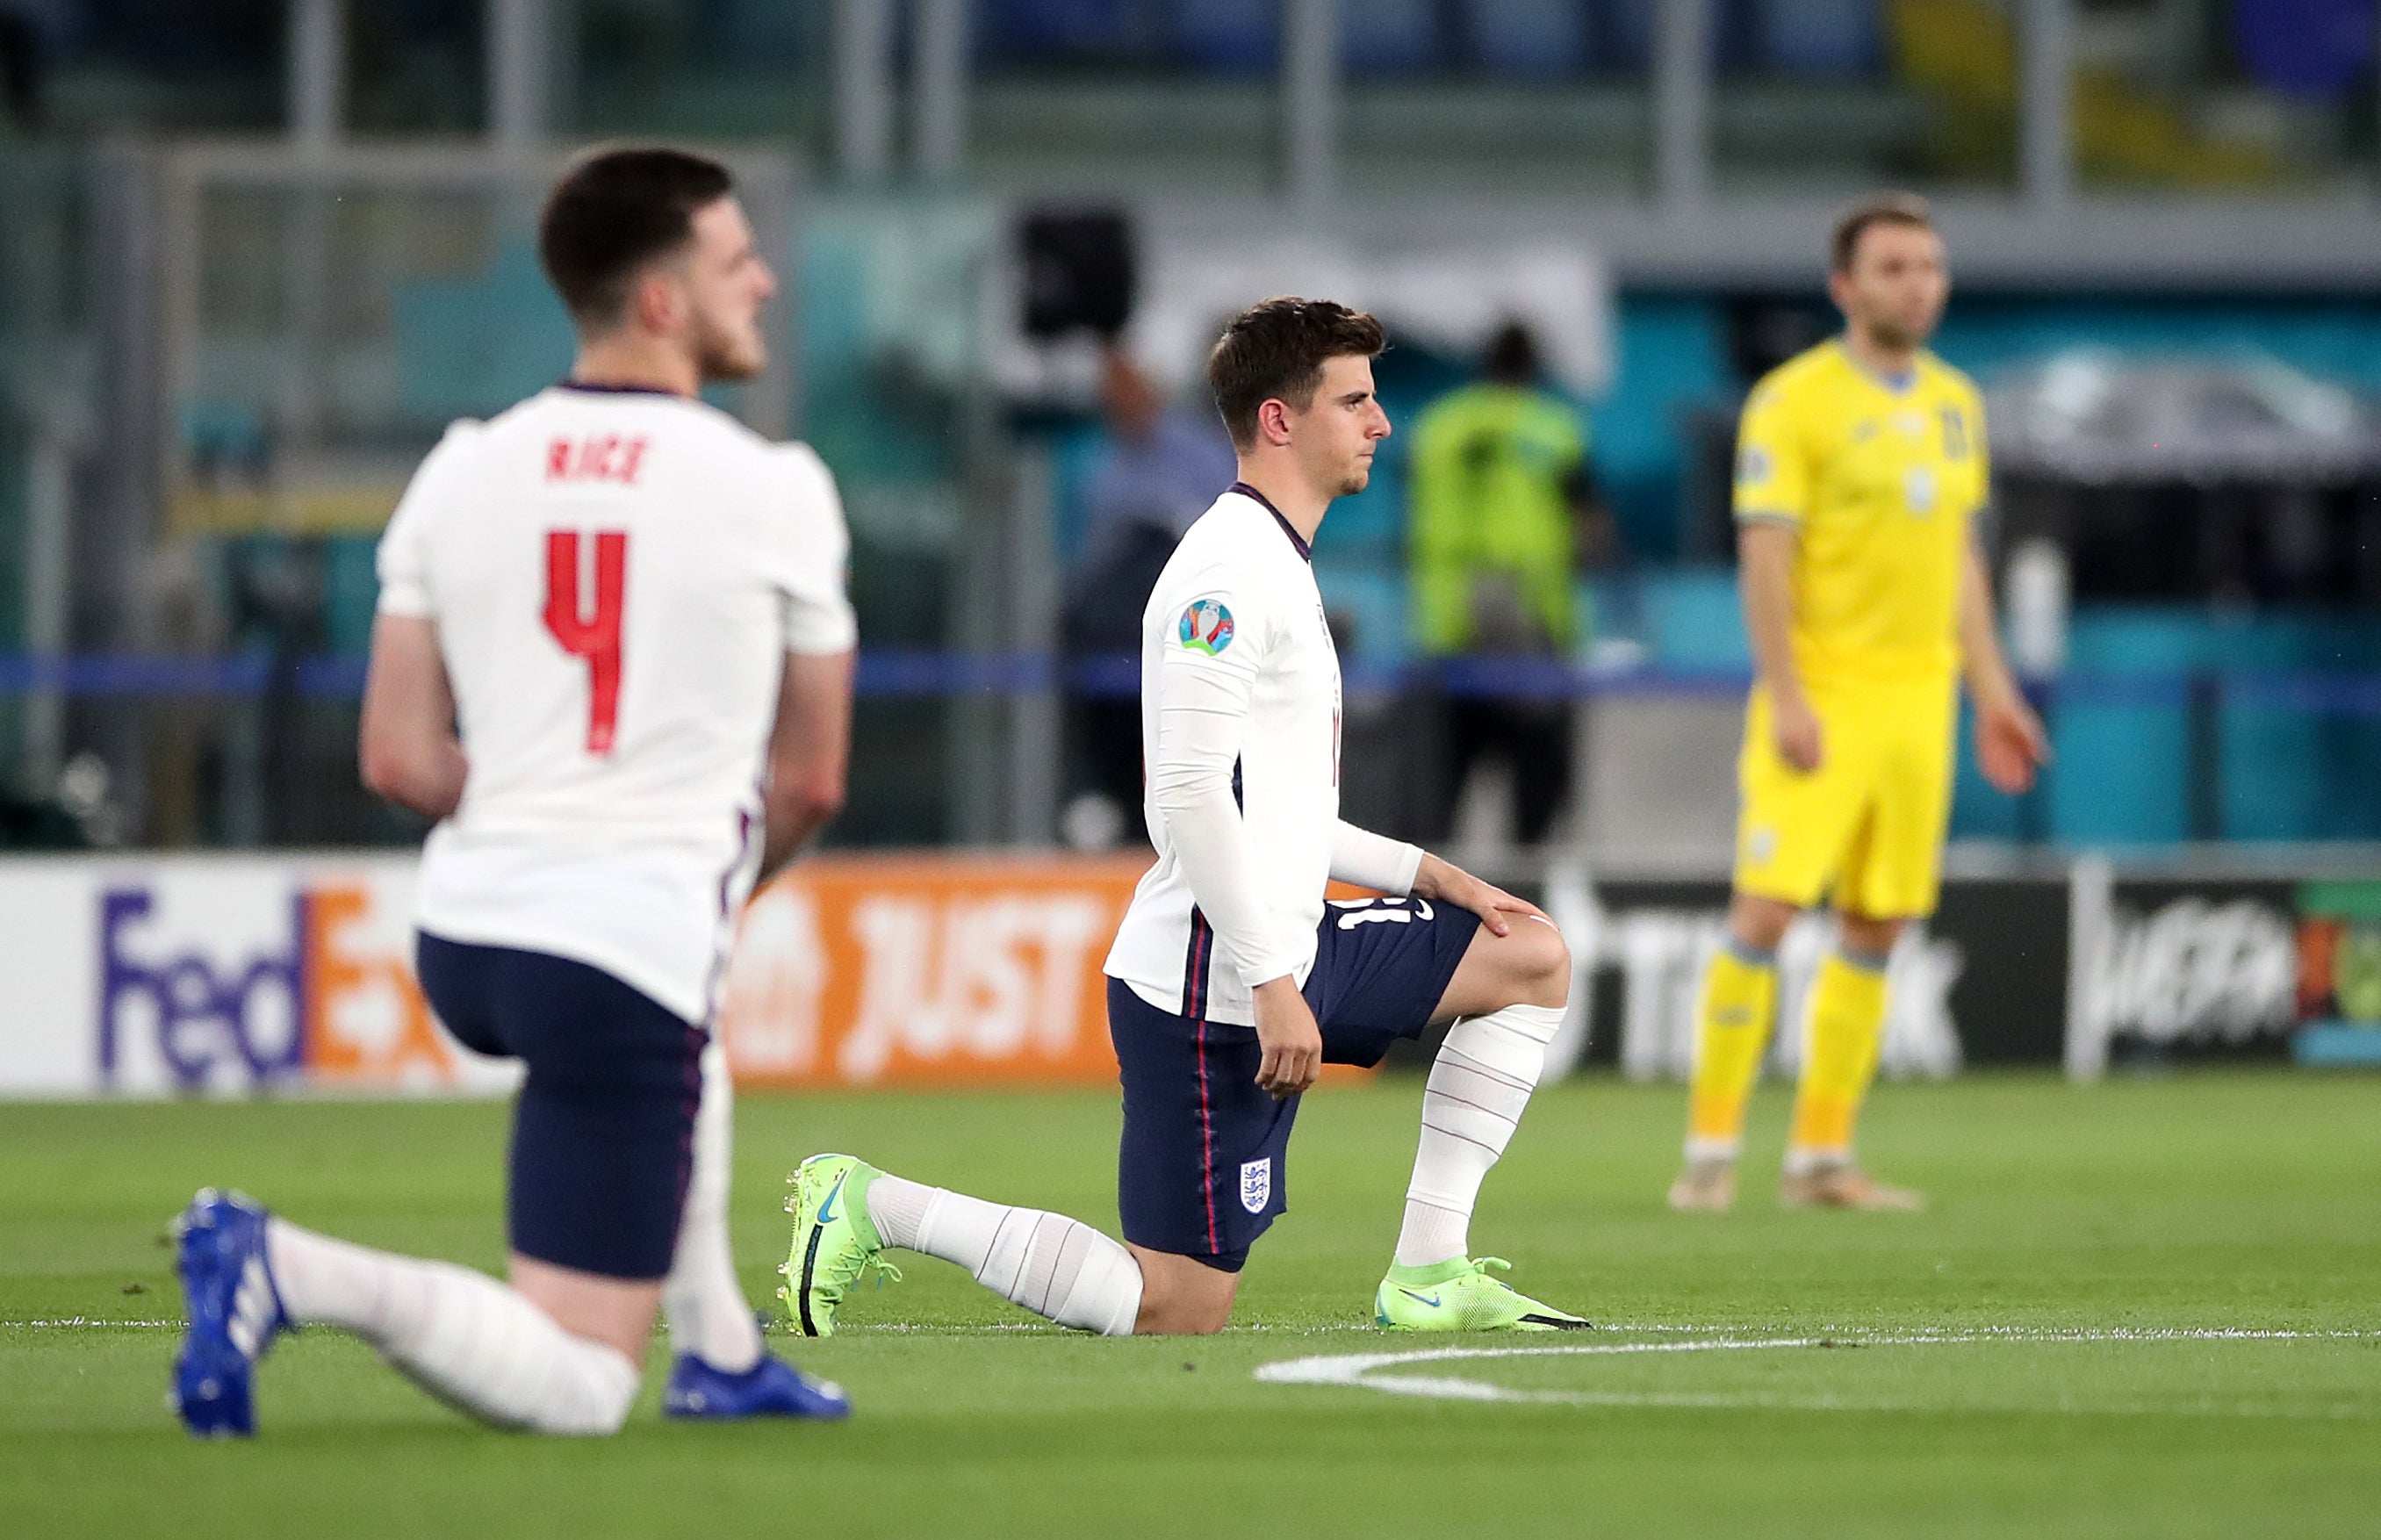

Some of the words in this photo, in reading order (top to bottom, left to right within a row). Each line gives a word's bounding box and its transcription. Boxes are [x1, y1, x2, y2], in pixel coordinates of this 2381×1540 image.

[546, 435, 649, 483] RICE
[543, 530, 625, 752] 4
[97, 885, 461, 1087] FedEx
[838, 894, 1104, 1083] JUST
